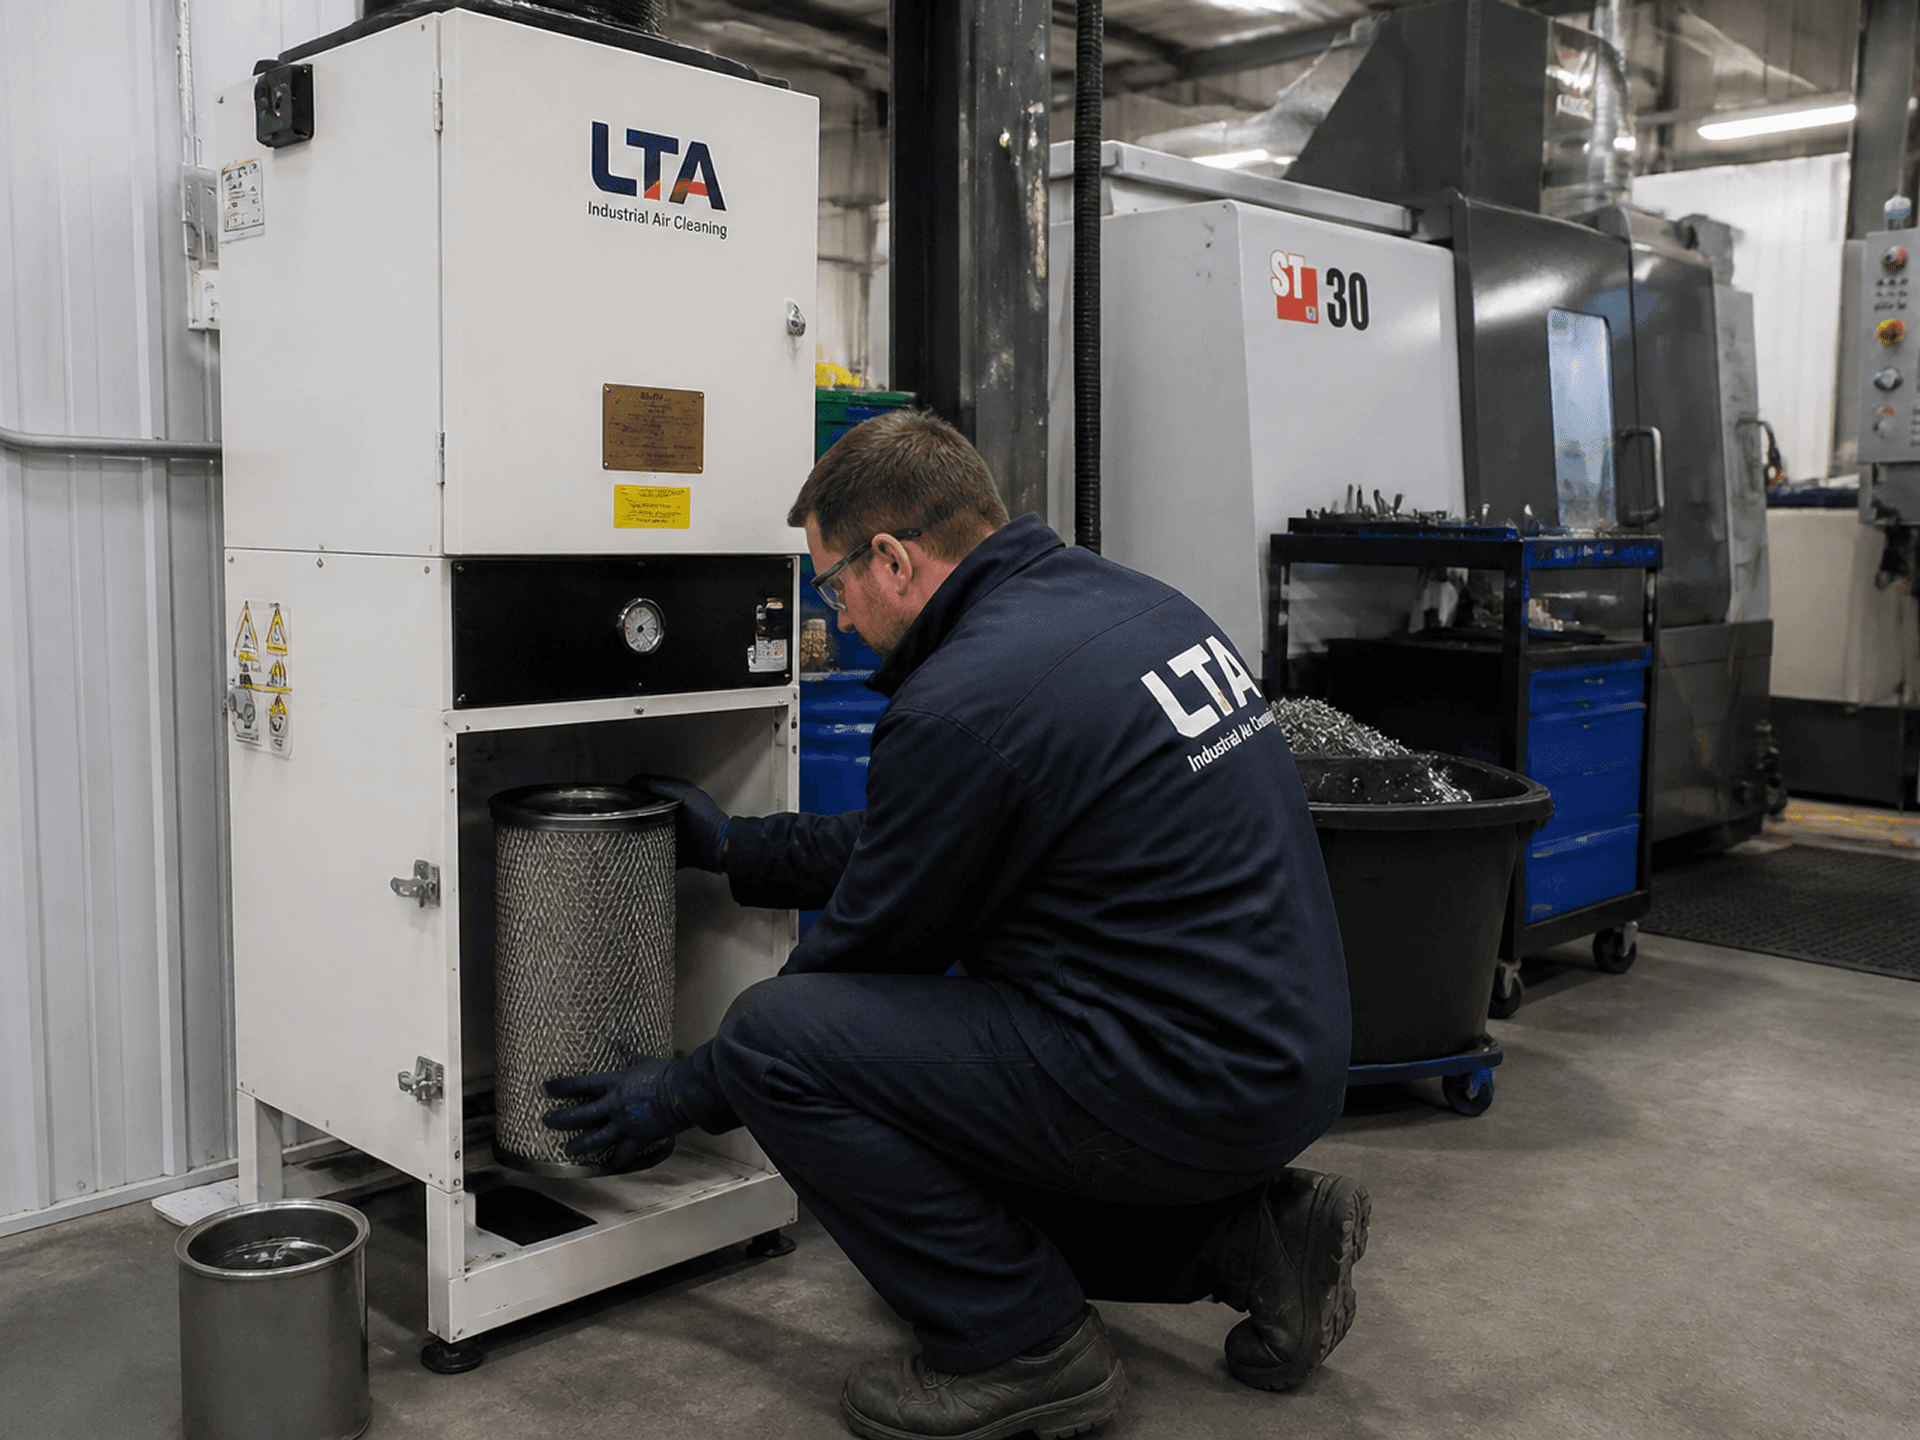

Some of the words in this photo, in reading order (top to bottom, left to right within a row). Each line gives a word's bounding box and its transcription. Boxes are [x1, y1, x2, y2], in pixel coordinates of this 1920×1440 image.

[592, 121, 726, 211] LTA
[588, 201, 649, 224] Industrial
[652, 212, 671, 228] Air
[674, 215, 728, 239] Cleaning
[1270, 249, 1305, 299] ST
[1326, 267, 1369, 331] 30
[1140, 635, 1262, 738] LTA
[1187, 728, 1242, 772] Industrial
